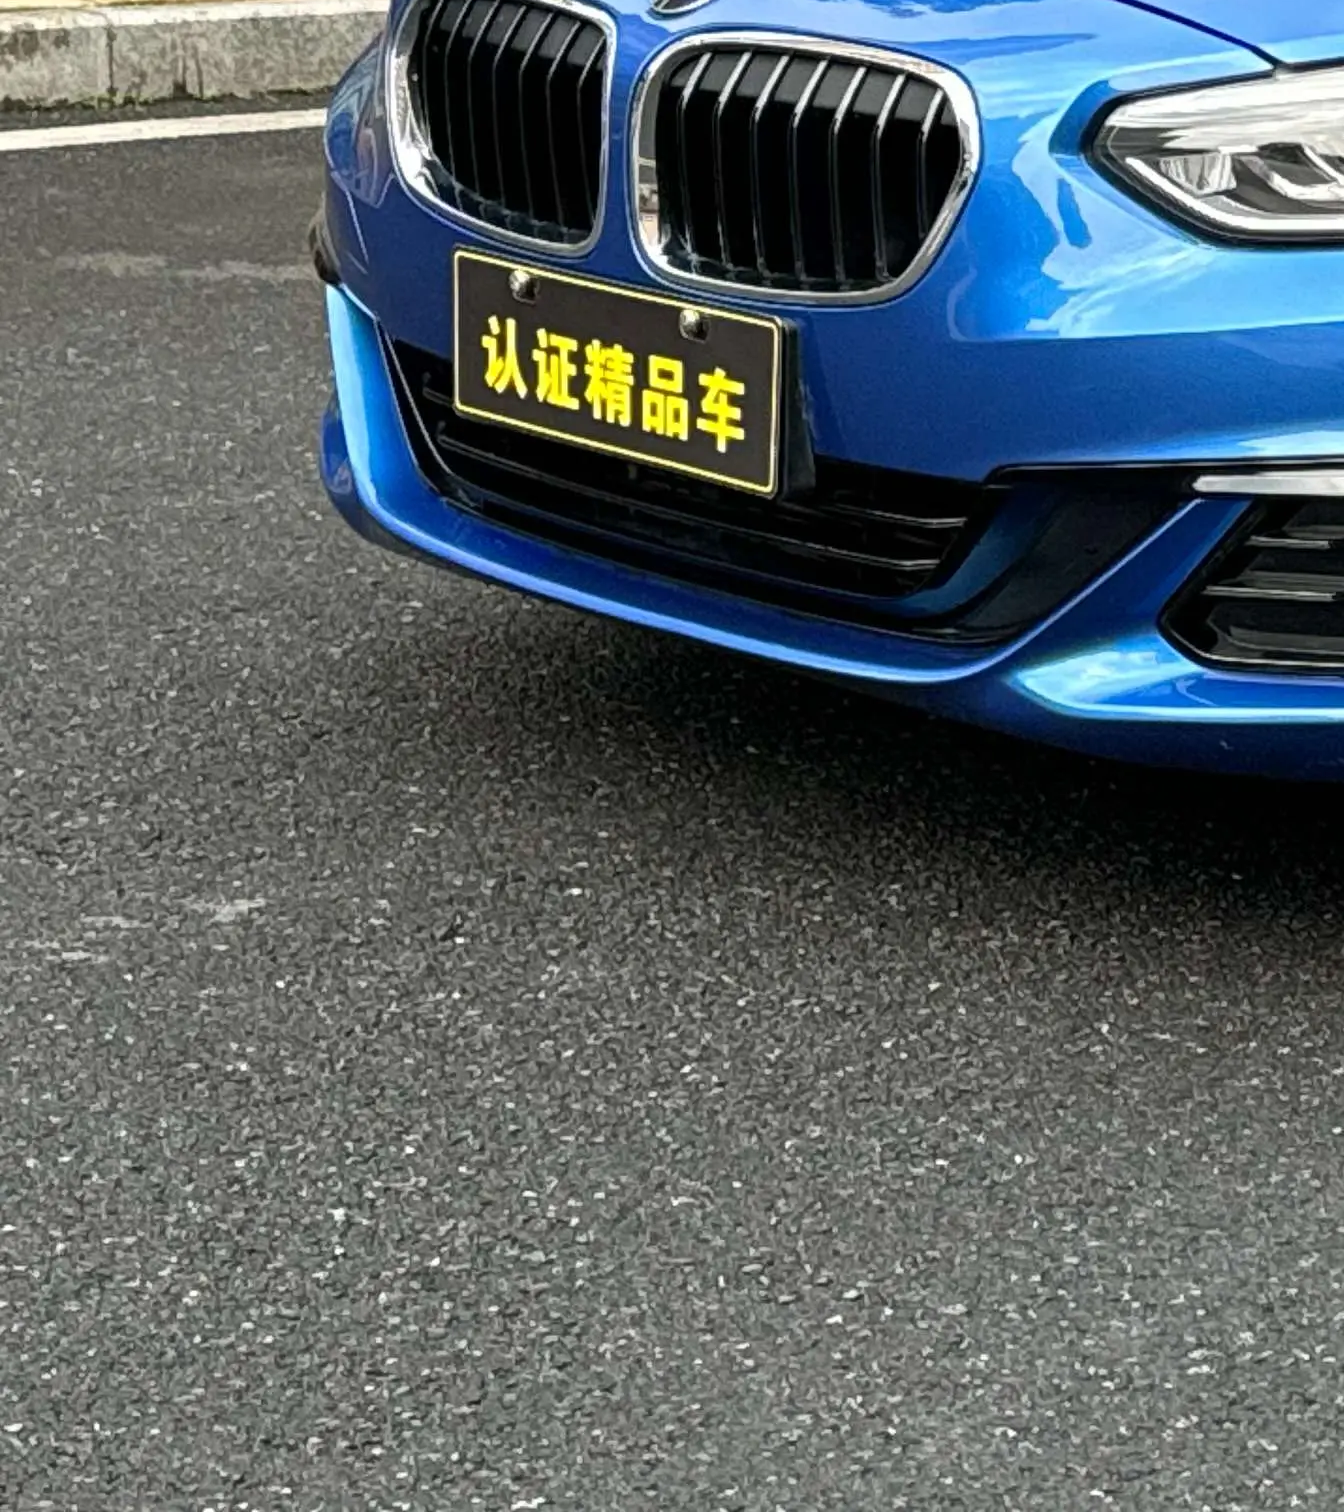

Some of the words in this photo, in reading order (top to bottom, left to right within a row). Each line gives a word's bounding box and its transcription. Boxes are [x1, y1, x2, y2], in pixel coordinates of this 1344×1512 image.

[481, 314, 746, 454] 认证精品车
